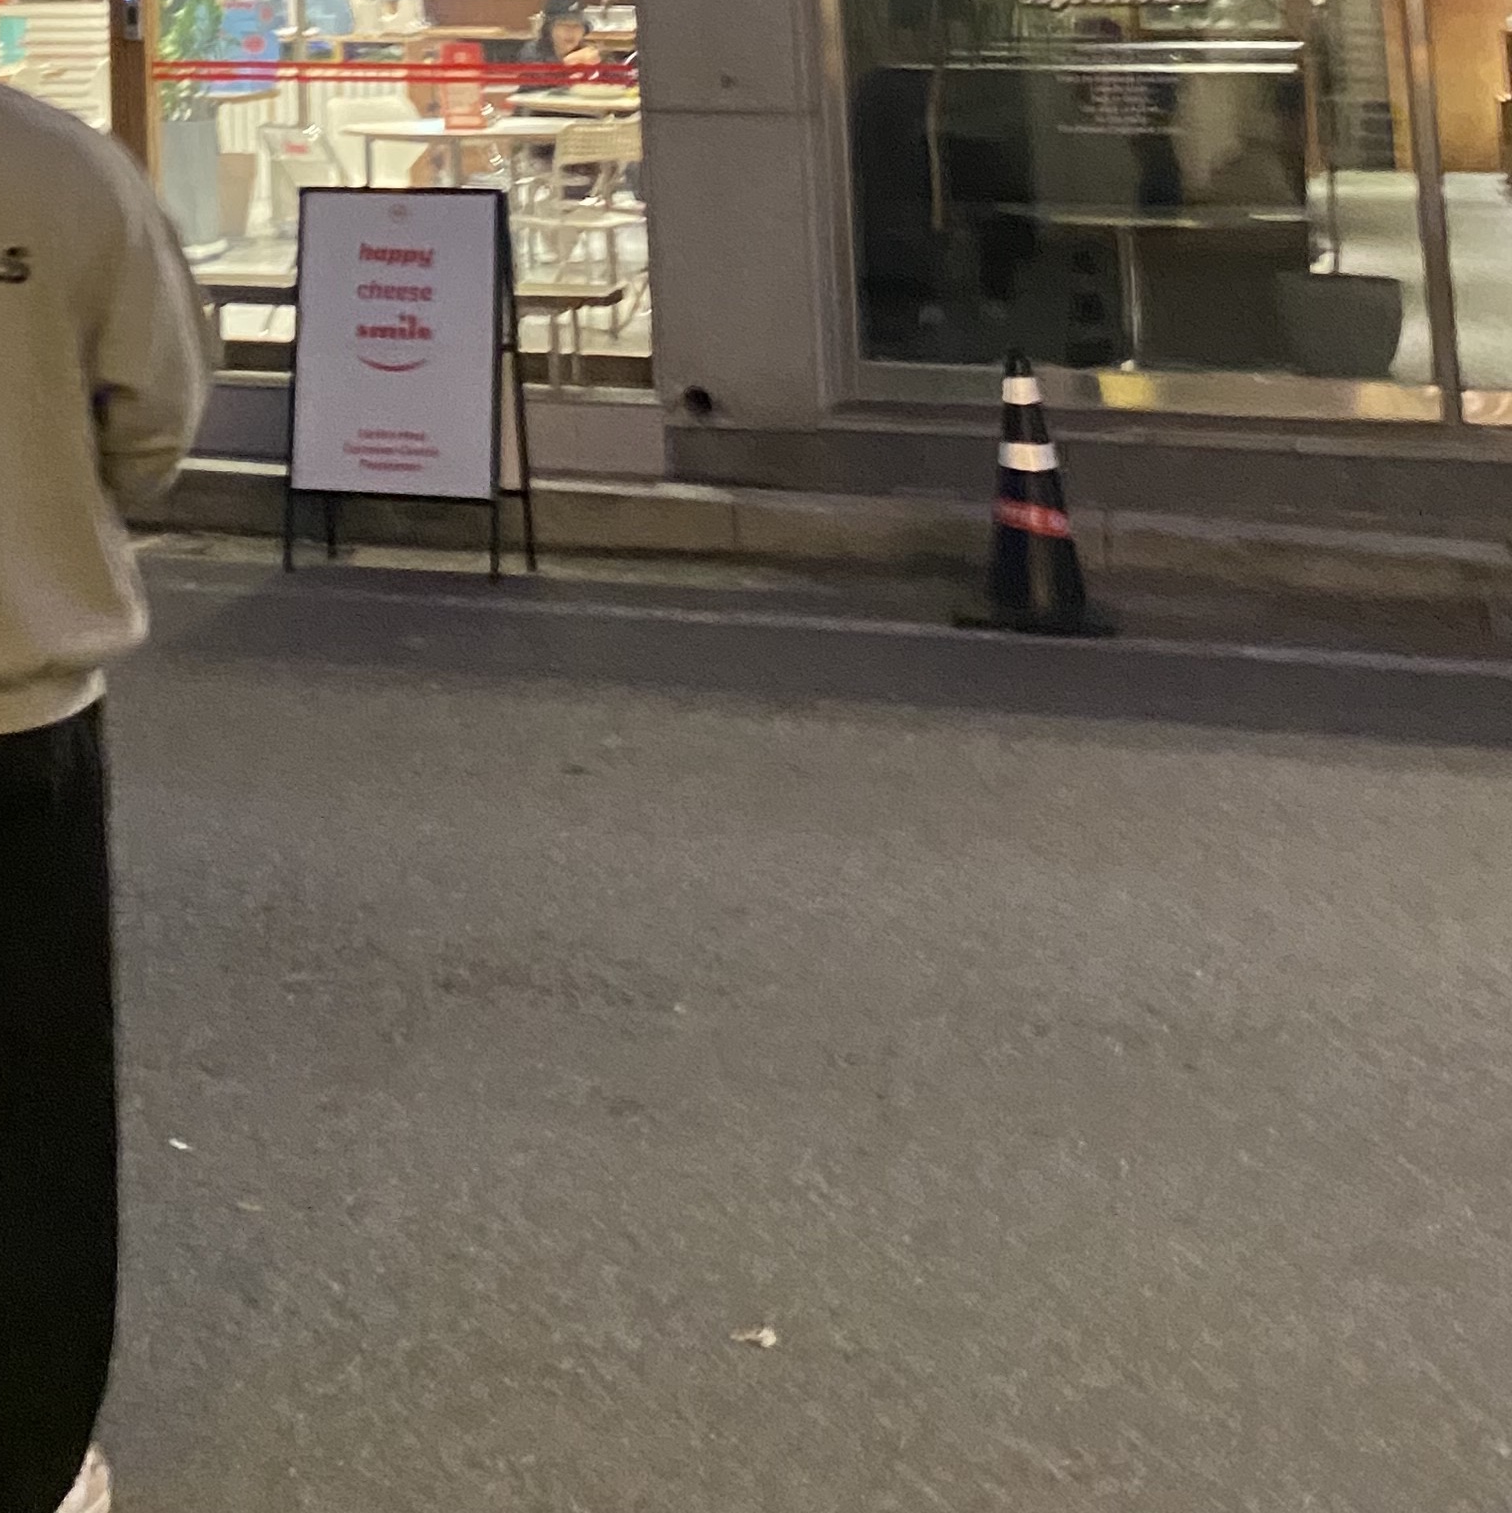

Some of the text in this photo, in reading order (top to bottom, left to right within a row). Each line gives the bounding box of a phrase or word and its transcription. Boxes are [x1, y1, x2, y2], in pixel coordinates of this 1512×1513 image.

[359, 243, 433, 267] happy
[358, 281, 432, 301] cheese
[356, 314, 431, 339] smile
